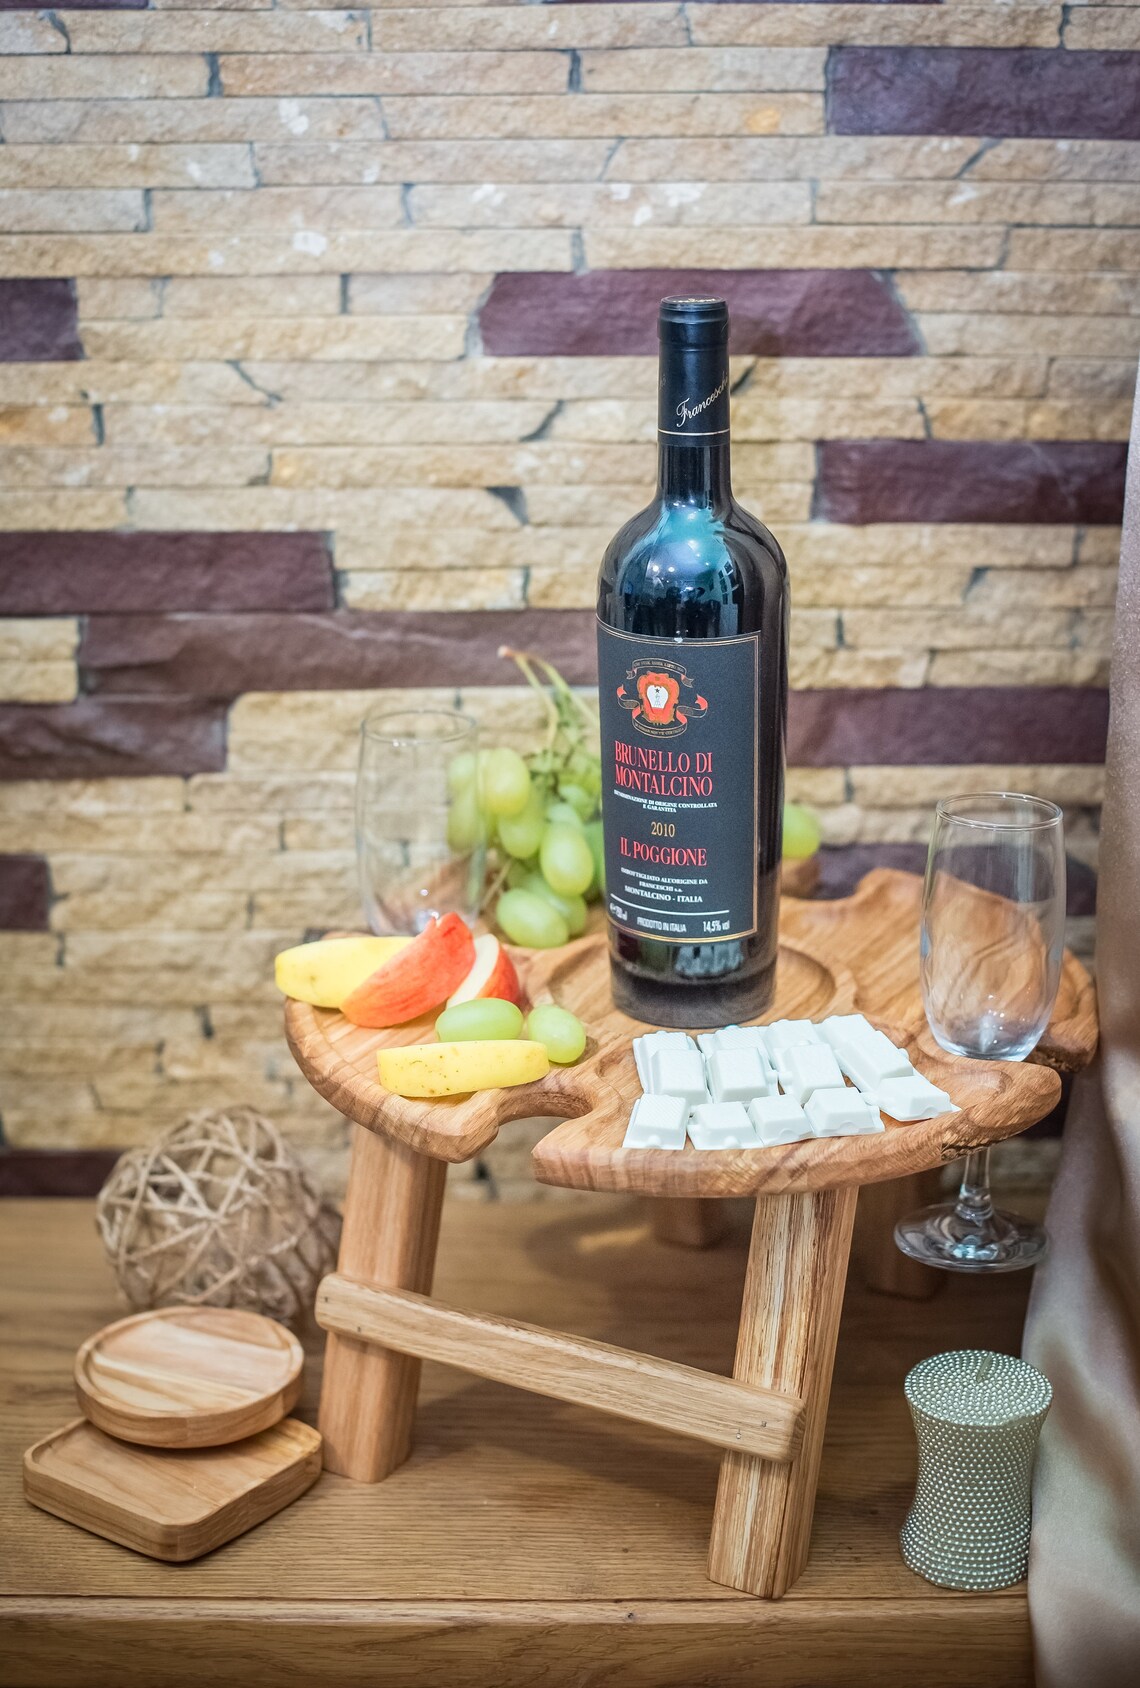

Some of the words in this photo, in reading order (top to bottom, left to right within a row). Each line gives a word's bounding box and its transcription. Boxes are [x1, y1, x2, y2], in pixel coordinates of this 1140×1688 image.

[614, 740, 691, 773] BRUNELLO
[695, 752, 713, 773] DI
[615, 763, 713, 797] MONTALCINO
[647, 805, 677, 813] GARANTITA
[654, 800, 678, 808] ORIGINE
[650, 821, 676, 838] 2010
[620, 836, 632, 857] IL
[633, 840, 708, 867] POGGIONE
[624, 885, 672, 902] MONTALCINO
[677, 895, 703, 903] ITALIA
[639, 880, 674, 892] FRANCESCHI
[637, 916, 662, 930] PRODOTTO
[662, 922, 669, 931] IN
[669, 923, 687, 933] ITALIA
[702, 920, 722, 933] 14,5%
[721, 920, 730, 931] vol
